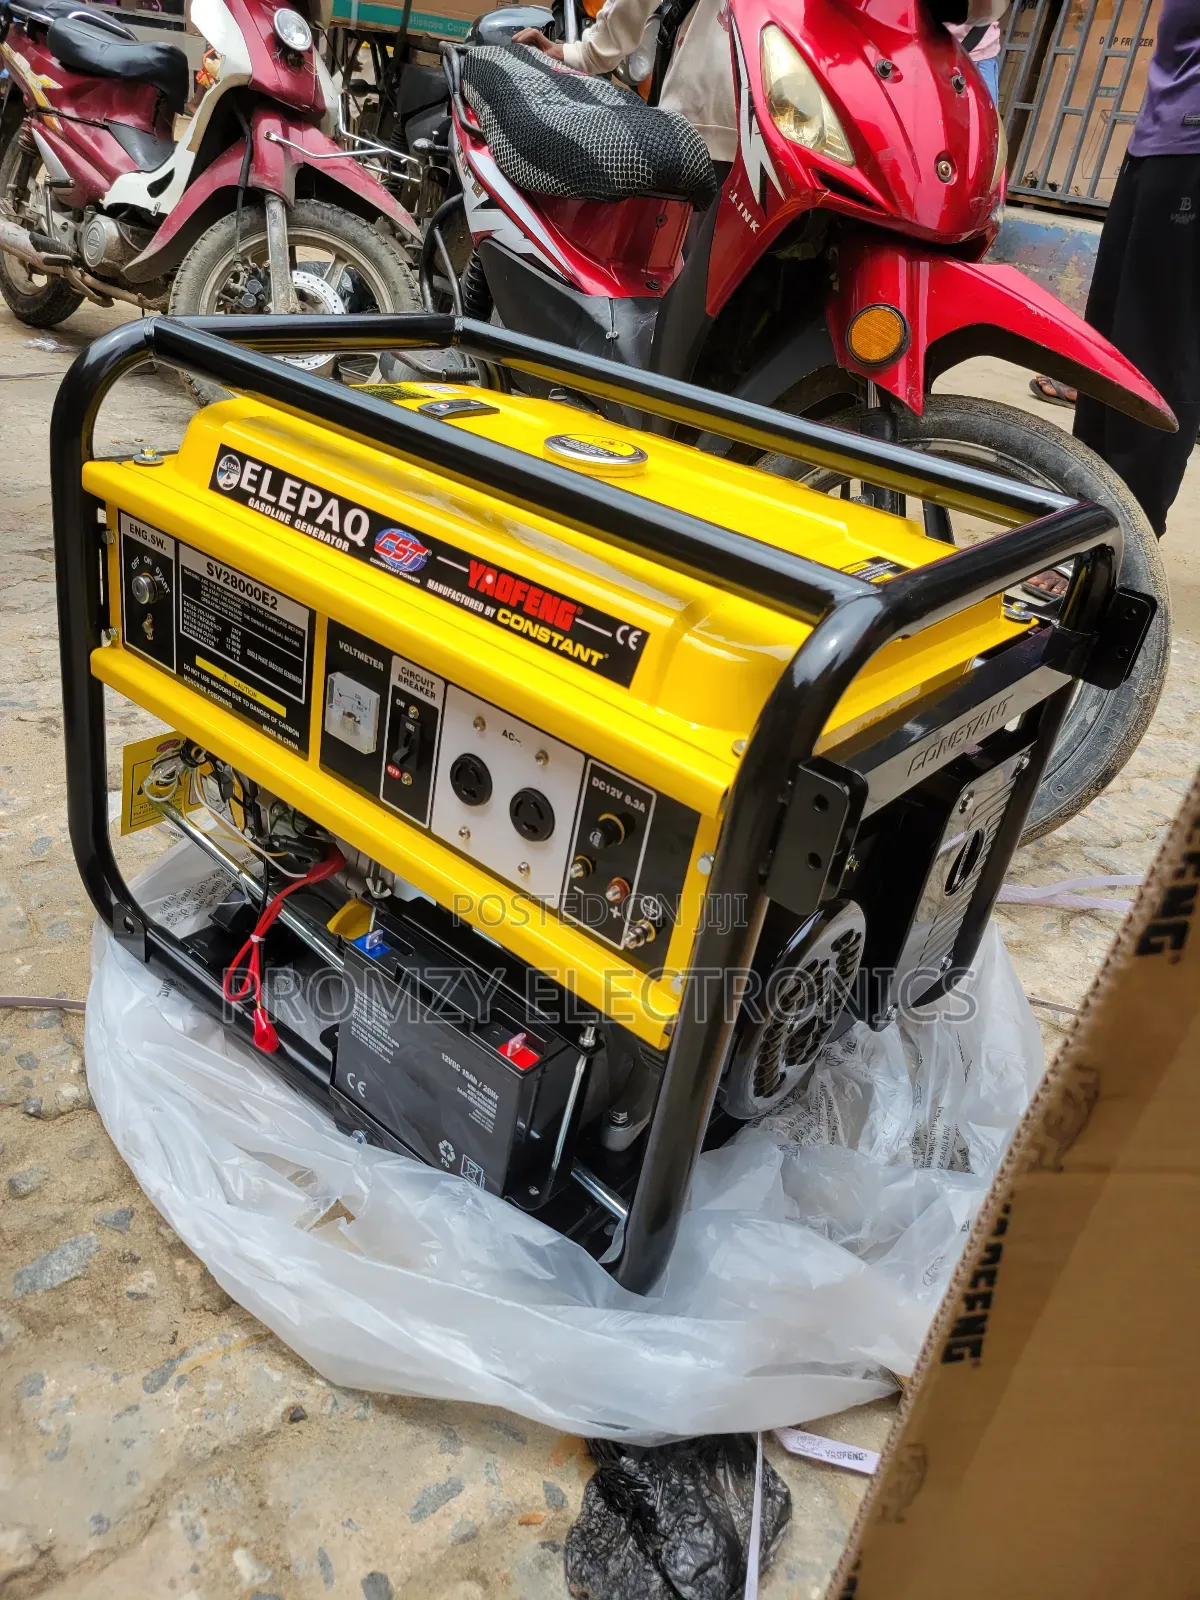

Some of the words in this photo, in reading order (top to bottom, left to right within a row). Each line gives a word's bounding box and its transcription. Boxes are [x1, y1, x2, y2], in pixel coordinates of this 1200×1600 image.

[410, 16, 444, 30] Hisense
[240, 460, 370, 547] ELEPAQ
[129, 522, 167, 552] ENG.SW.
[248, 498, 292, 524] GASOLINE
[294, 518, 350, 552] GENERATOR
[131, 556, 140, 570] OFF
[144, 556, 152, 566] ON
[374, 532, 428, 566] CST
[156, 566, 170, 594] START
[370, 557, 400, 575] CONSTANT
[206, 562, 278, 610] SV28000E2
[427, 578, 484, 614] MANUFACTURED
[484, 606, 496, 618] BY
[468, 560, 577, 632] YAOFENG
[496, 608, 604, 667] CONSTANT
[338, 640, 384, 672] VOLTMETER
[234, 680, 258, 698] CAUTION
[398, 674, 436, 701] BREAKER
[400, 666, 436, 690] CIRCUIT
[183, 662, 190, 672] DO
[190, 666, 199, 678] NOT
[200, 672, 210, 684] USE
[210, 678, 231, 698] INDOORS
[231, 691, 241, 703] DUE
[242, 697, 249, 708] TO
[250, 701, 270, 721] DANGER
[270, 714, 277, 725] OF
[278, 719, 299, 738] CARBON
[207, 687, 232, 710] POISONING
[396, 698, 406, 709] ON
[262, 722, 276, 738] MADE
[277, 733, 282, 741] IN
[283, 735, 298, 752] CHINA
[387, 766, 400, 777] OFF
[592, 776, 622, 800] DC12V
[442, 1052, 460, 1072] 12VDC
[462, 1068, 478, 1085] 15Ah
[482, 1084, 499, 1100] 20Hr
[440, 1157, 450, 1168] Pb
